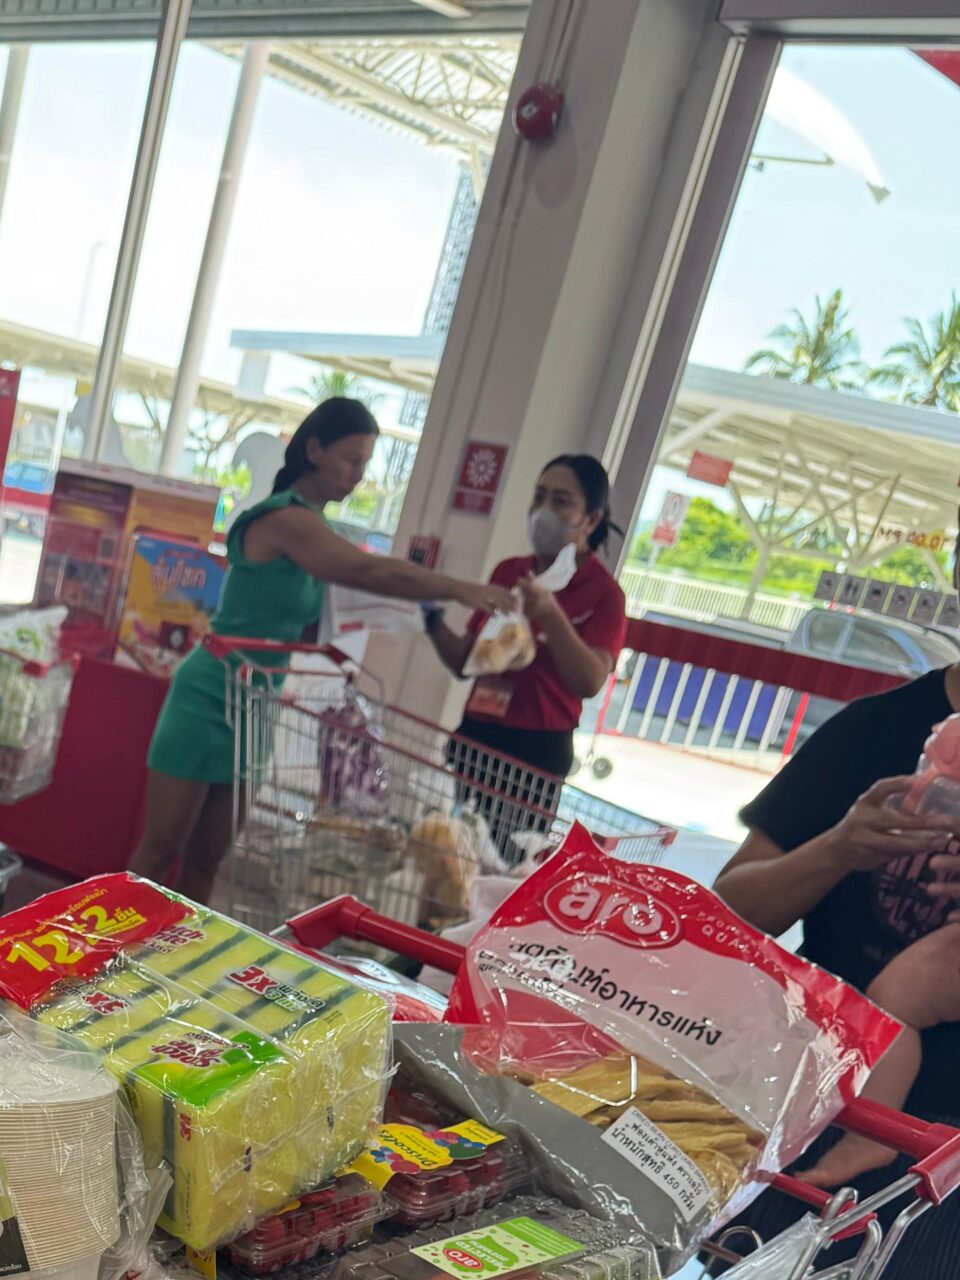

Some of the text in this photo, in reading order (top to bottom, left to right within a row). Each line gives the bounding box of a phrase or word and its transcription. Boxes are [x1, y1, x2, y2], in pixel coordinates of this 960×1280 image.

[558, 882, 663, 935] aro
[227, 965, 279, 995] 3X
[611, 1122, 696, 1212] น้ำหนักสุทธิ 450 กรัม
[448, 1250, 479, 1268] aro
